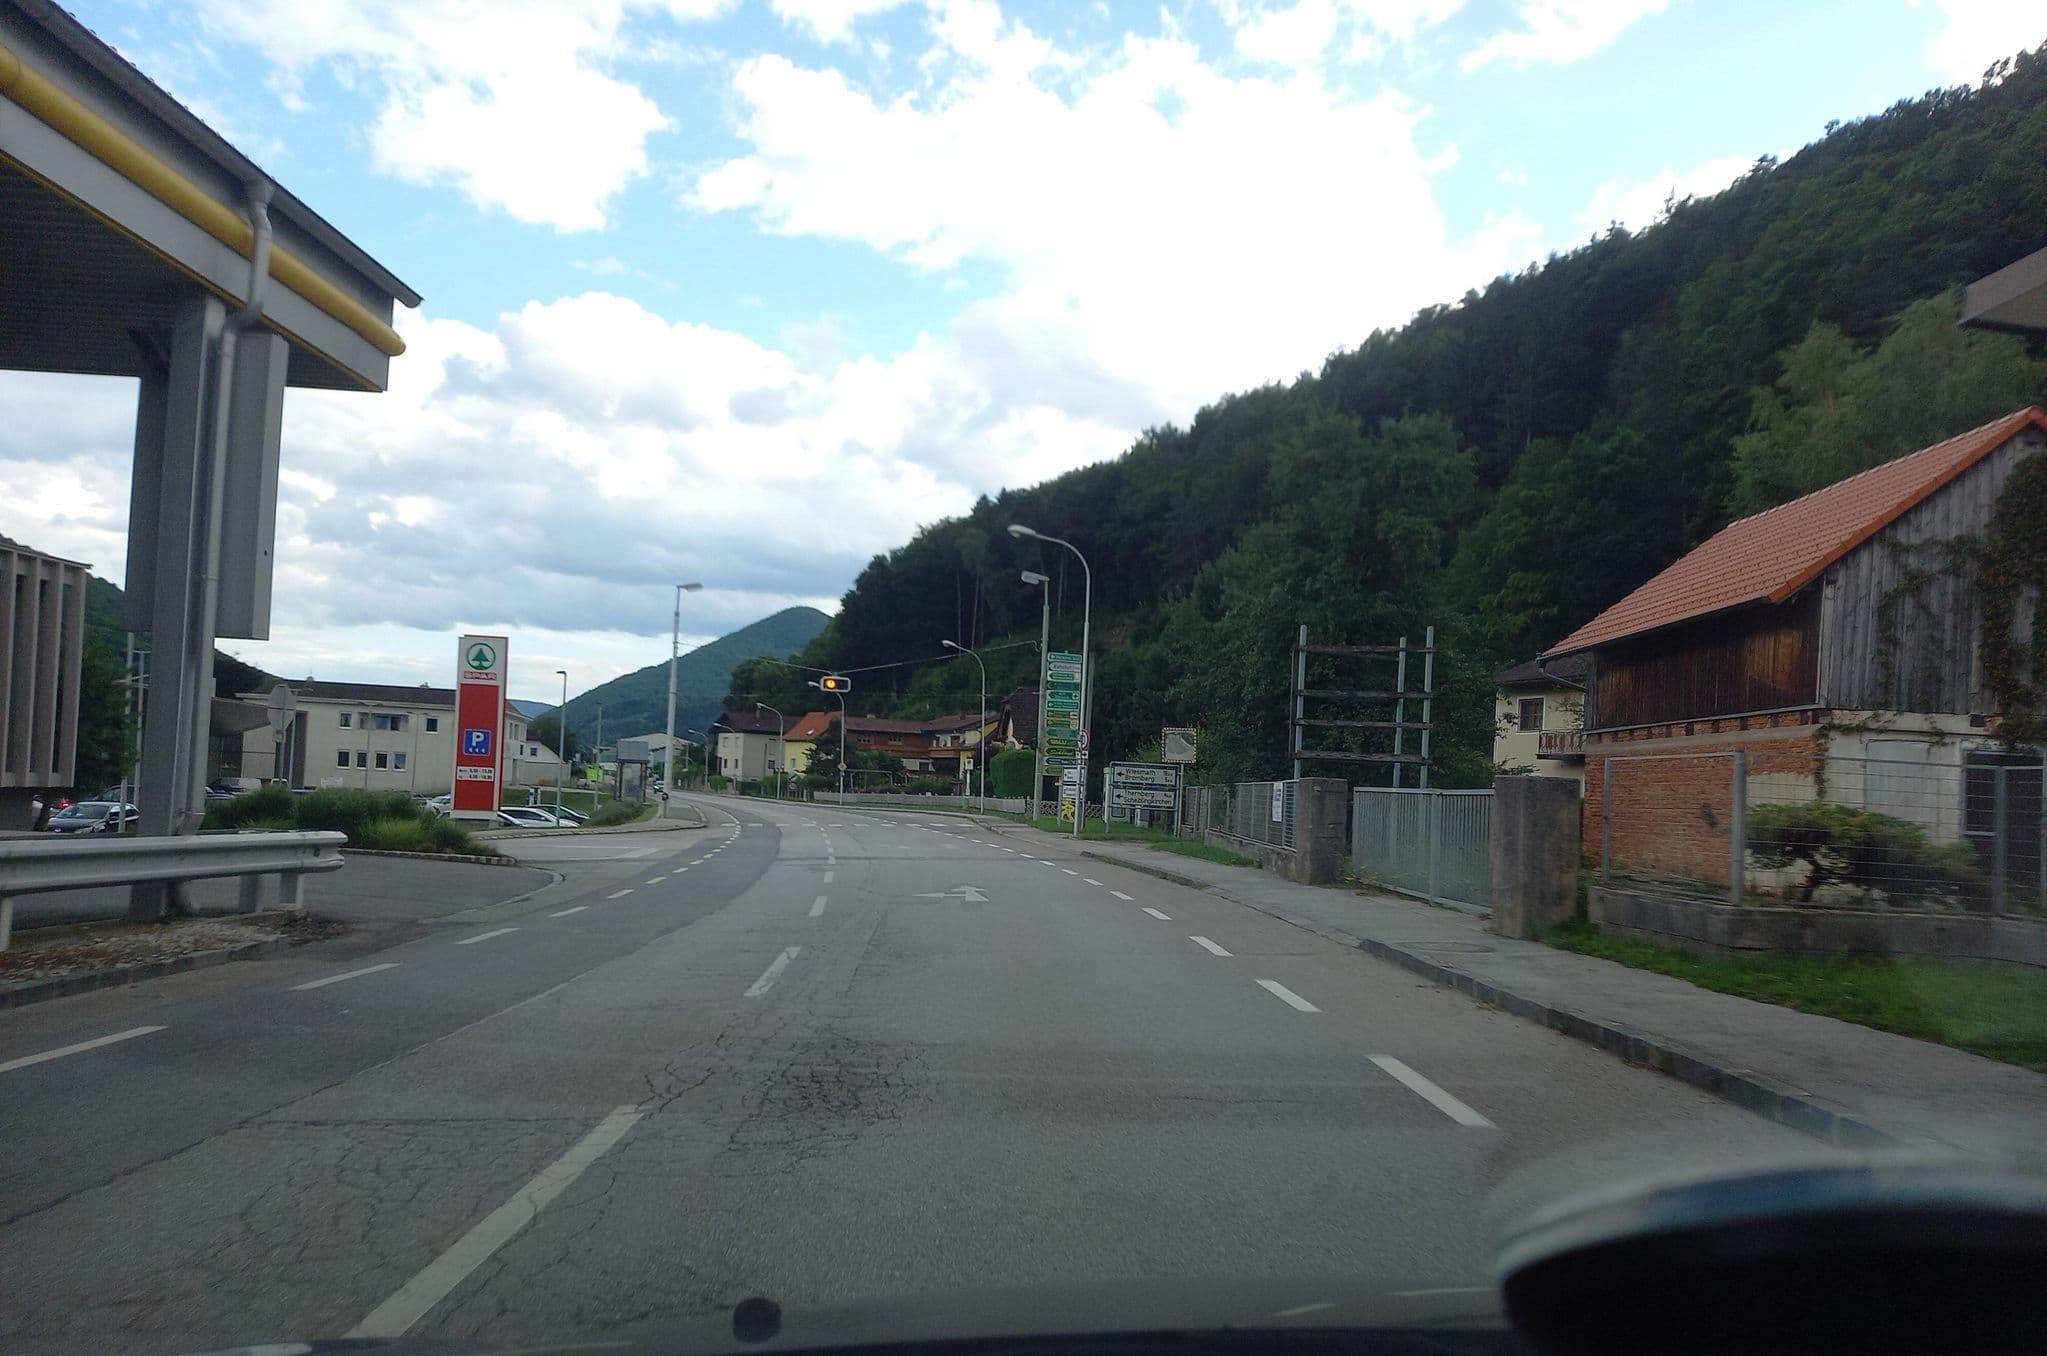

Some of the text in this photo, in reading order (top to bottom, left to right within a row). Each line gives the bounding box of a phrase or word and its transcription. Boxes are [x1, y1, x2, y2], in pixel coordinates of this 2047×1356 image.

[464, 671, 497, 680] SPAR
[472, 731, 485, 747] P
[1125, 768, 1156, 776] Wiesmath
[1125, 775, 1155, 783] Bromberg
